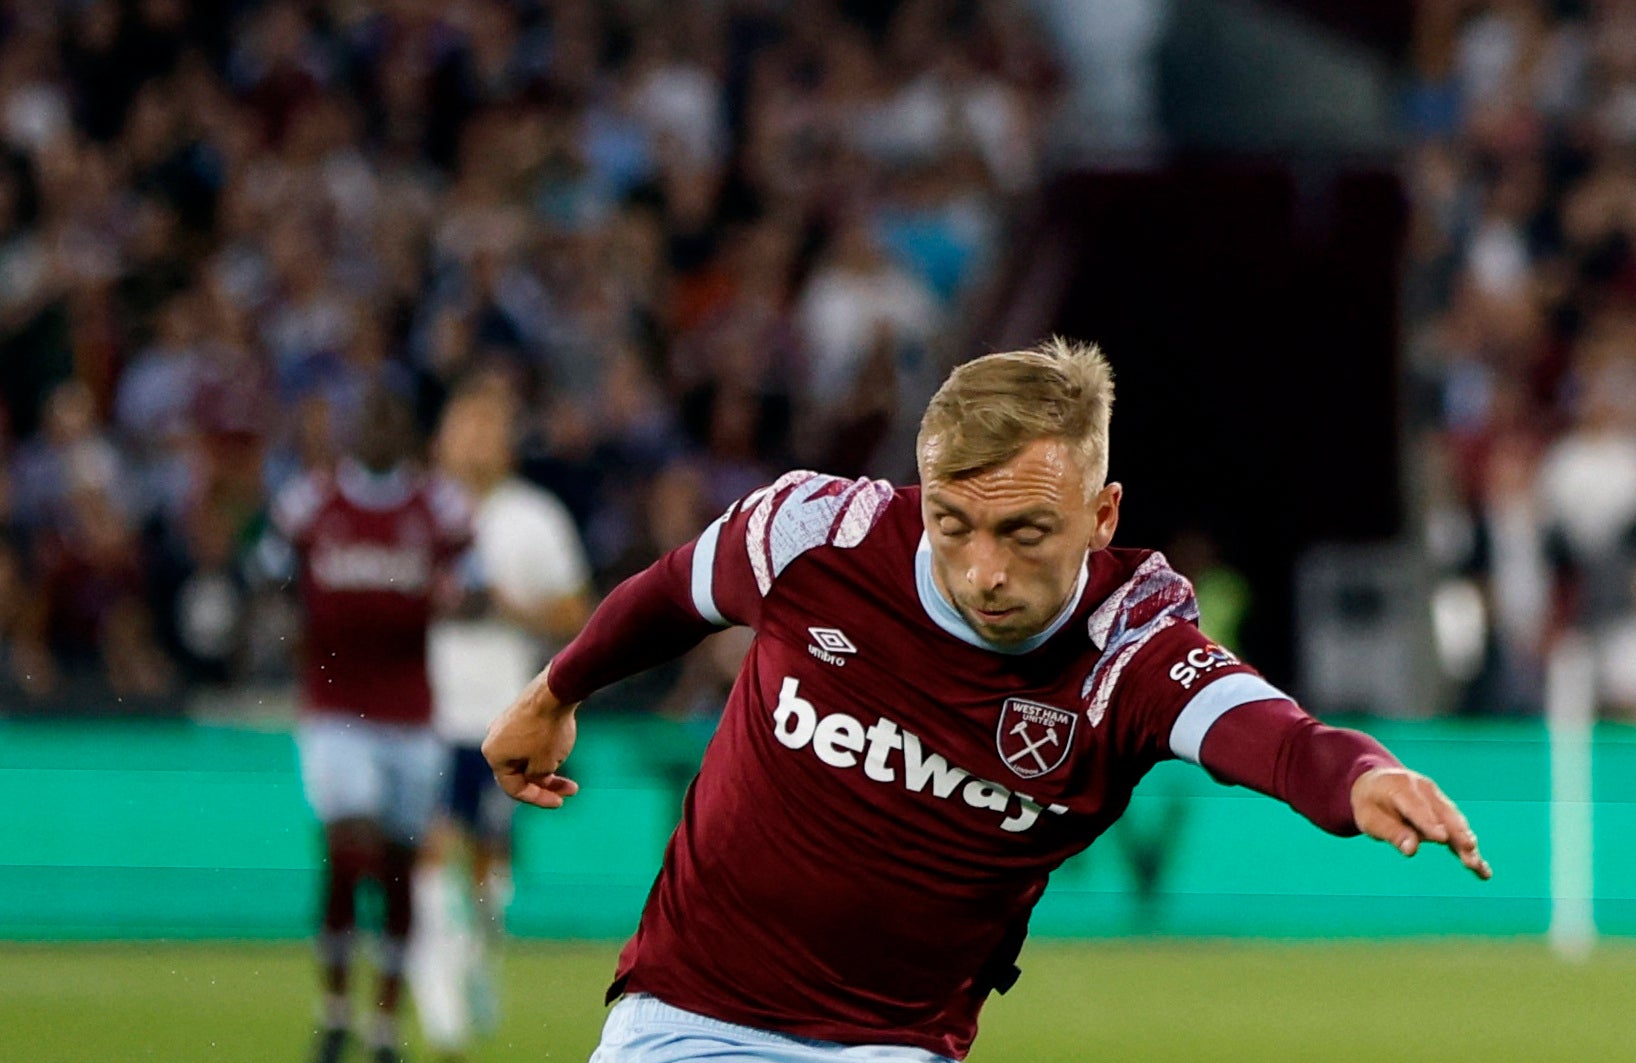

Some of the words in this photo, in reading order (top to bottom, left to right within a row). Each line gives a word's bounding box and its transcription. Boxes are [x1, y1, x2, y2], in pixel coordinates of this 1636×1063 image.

[808, 643, 845, 667] umbro
[1012, 702, 1042, 717] WEST
[1042, 709, 1069, 725] HAM
[1022, 713, 1055, 728] UNITED
[773, 676, 1068, 833] betway
